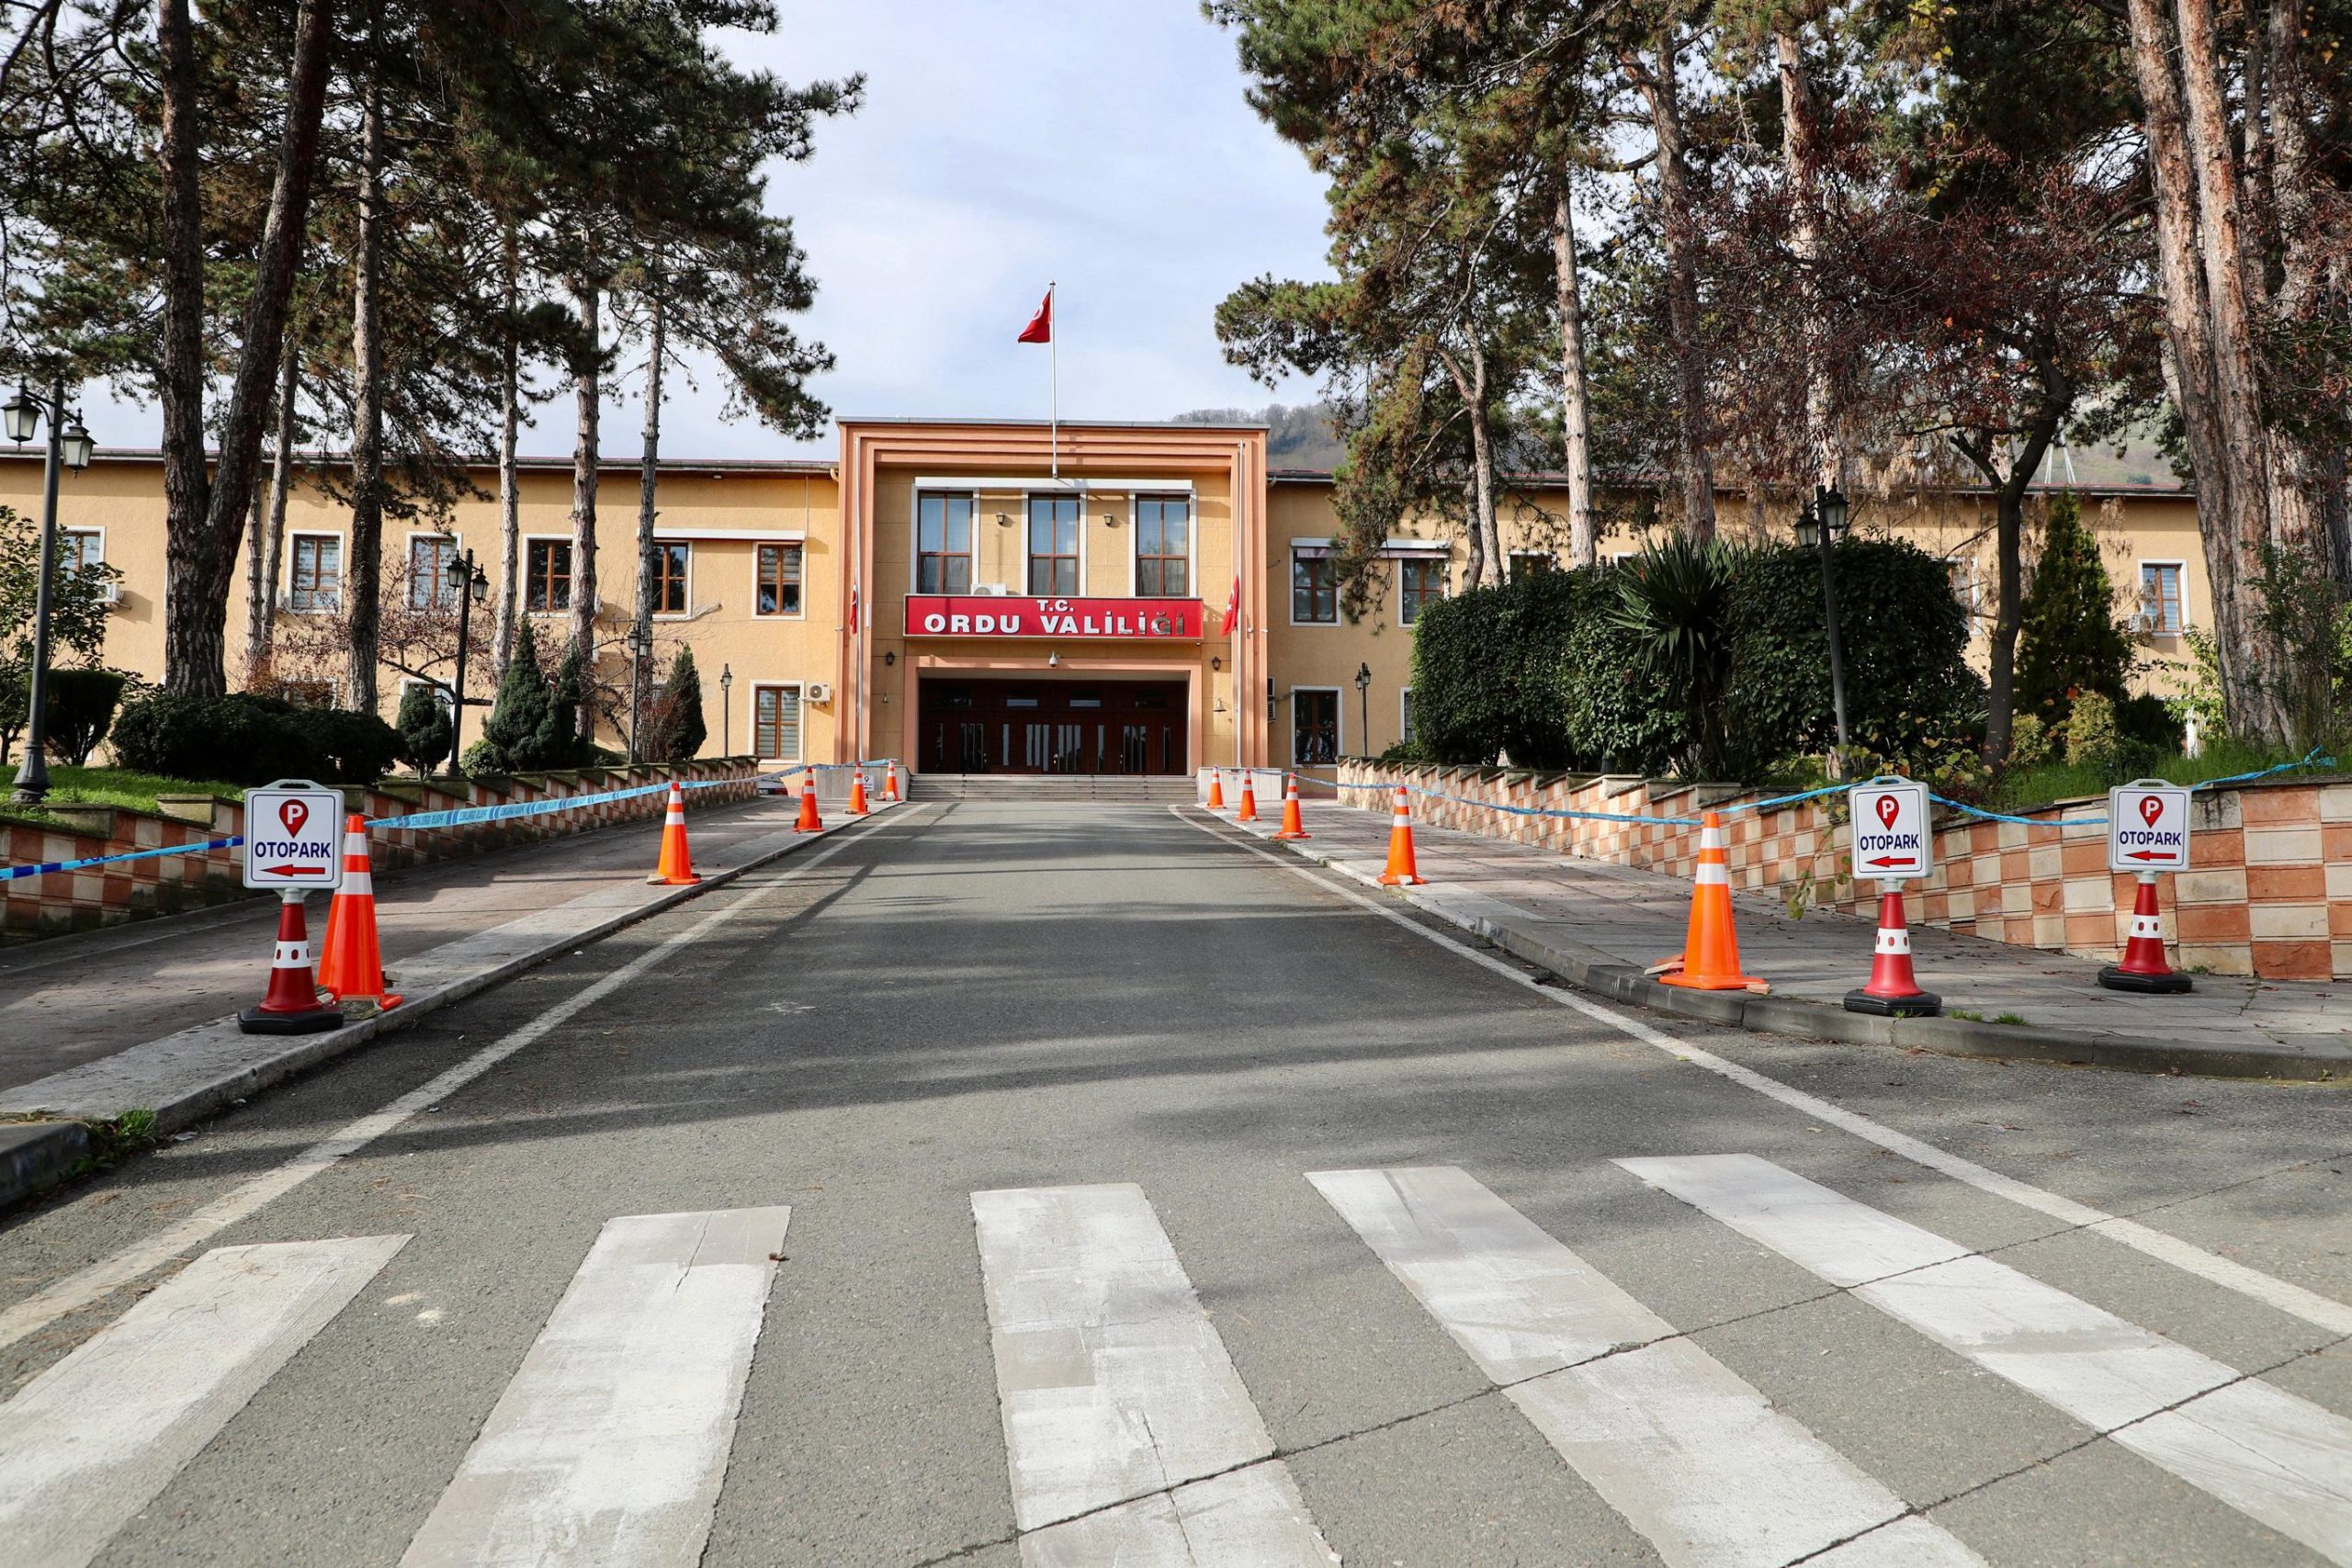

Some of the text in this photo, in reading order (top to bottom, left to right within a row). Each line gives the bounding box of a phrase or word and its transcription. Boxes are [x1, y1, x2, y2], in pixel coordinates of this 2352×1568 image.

[1036, 599, 1074, 613] T.C.
[924, 611, 1184, 636] ORDU VALİLİĞİ
[287, 804, 303, 824] P
[1882, 799, 1895, 818] P
[2145, 800, 2159, 817] P
[1860, 833, 1919, 851] OTOPARK
[2120, 830, 2182, 846] OTOPARK
[254, 841, 331, 858] OTOPARK
